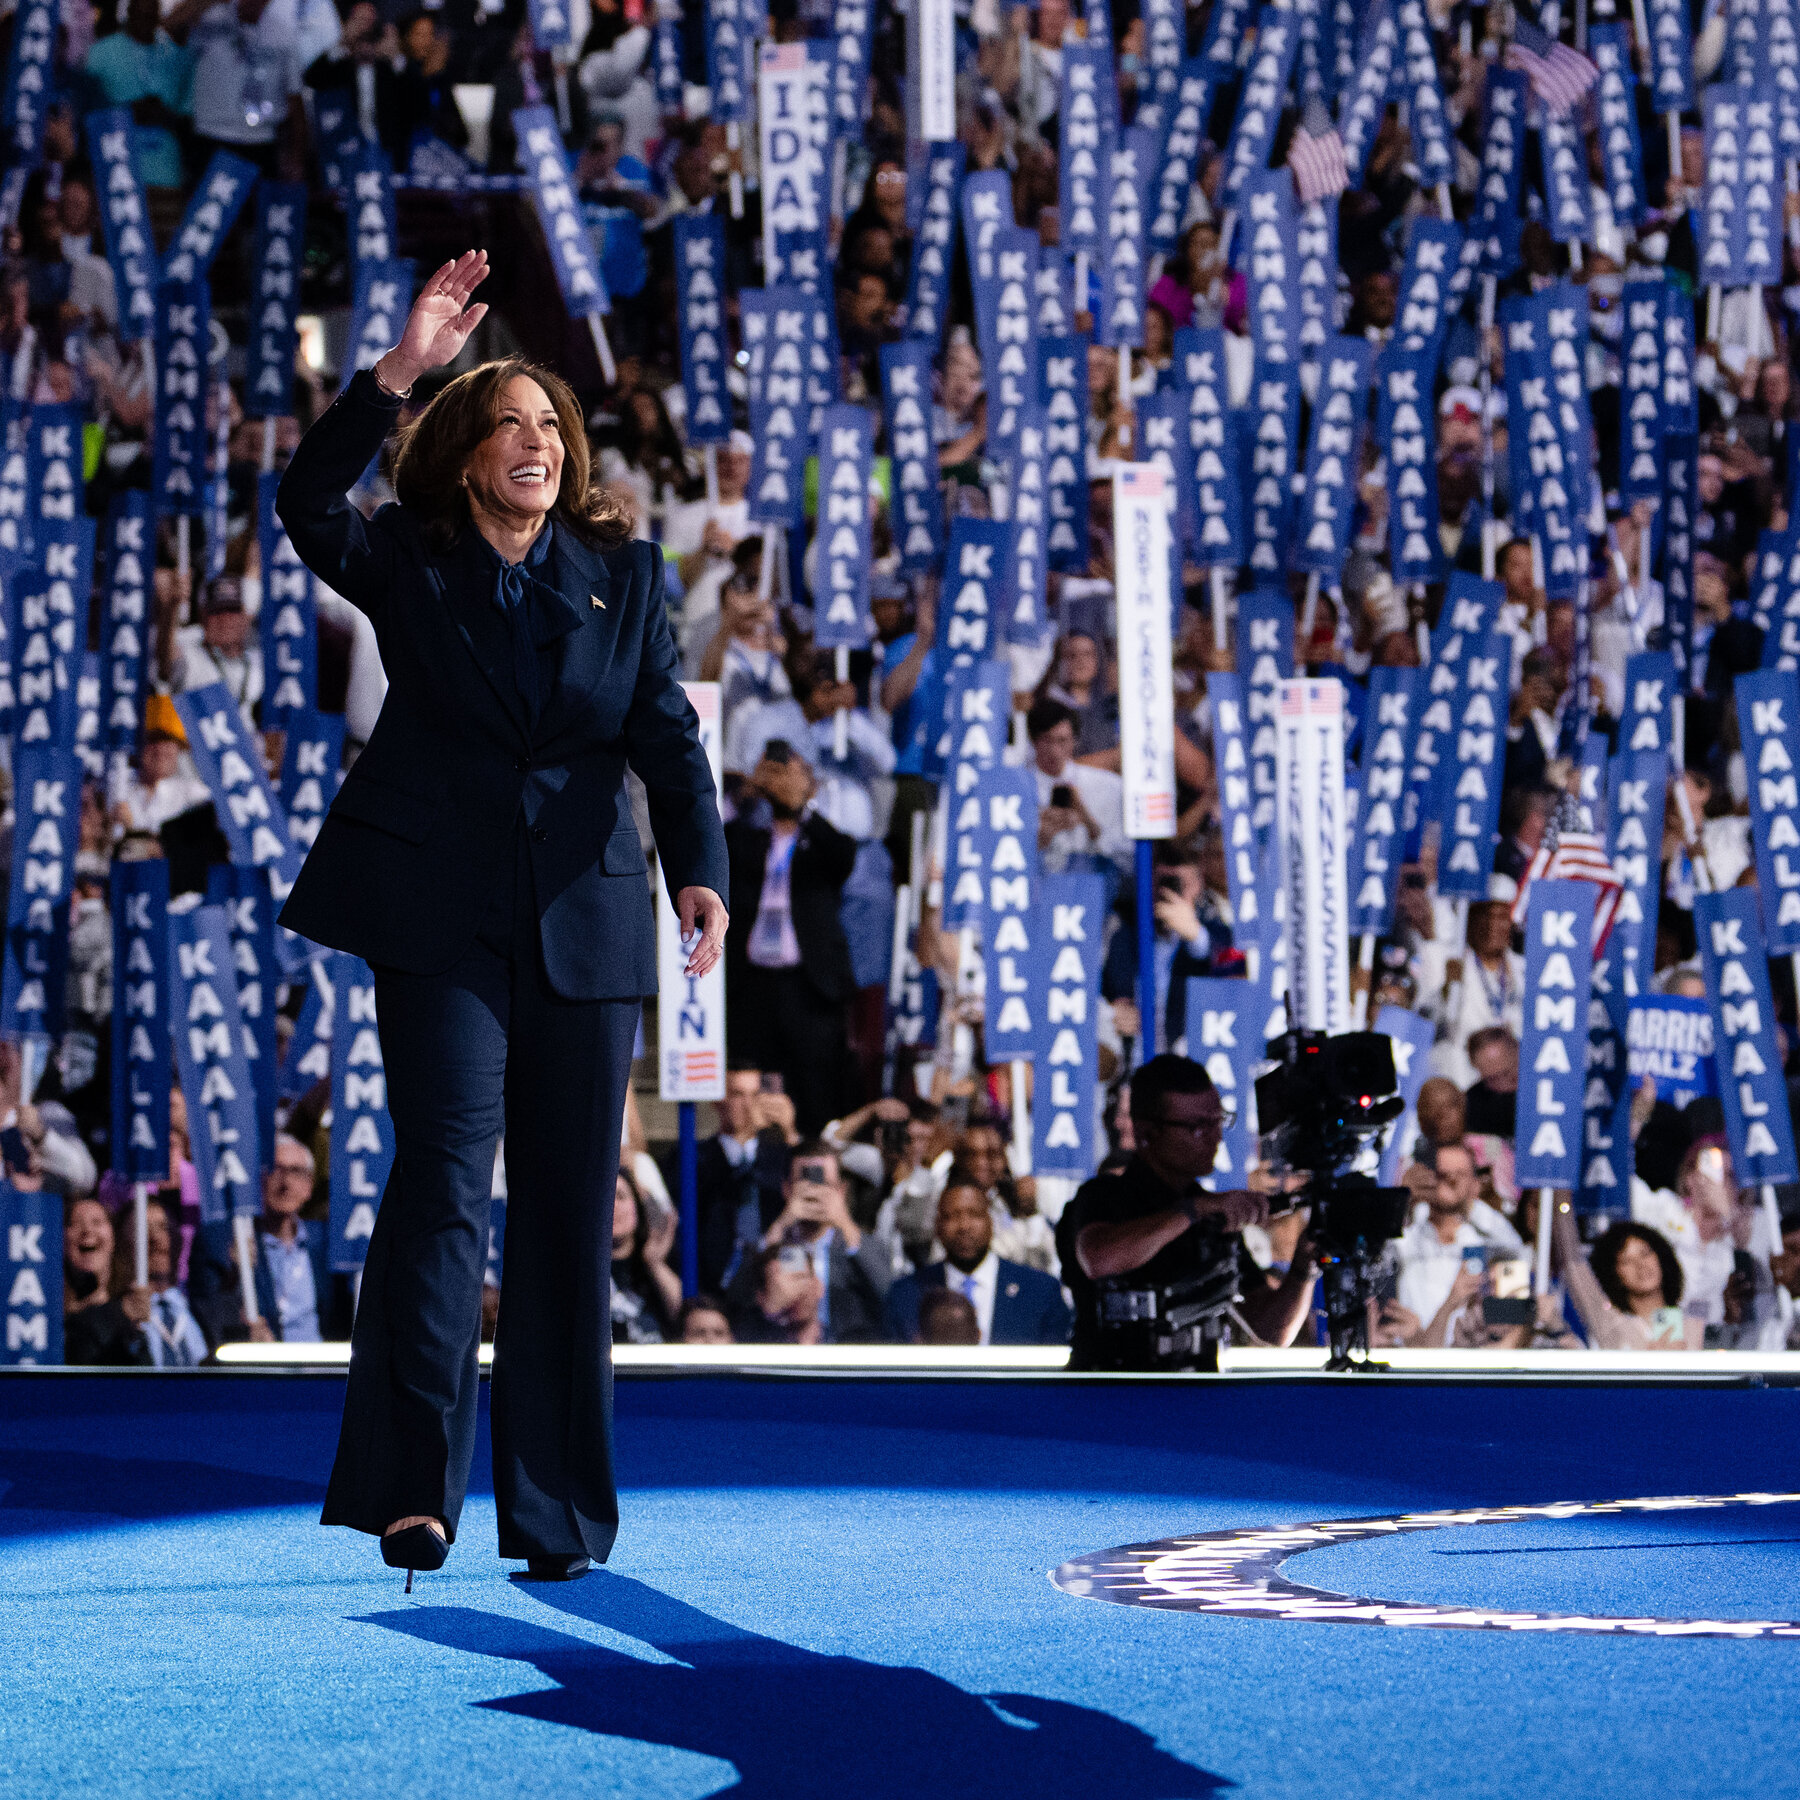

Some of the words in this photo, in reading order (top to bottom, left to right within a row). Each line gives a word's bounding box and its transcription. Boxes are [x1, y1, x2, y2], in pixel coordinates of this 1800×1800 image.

[15, 6, 50, 150] AMALA
[772, 82, 801, 210] IDA
[1067, 62, 1100, 236] KAMALA
[1151, 76, 1207, 239] KAMALA
[1402, 2, 1451, 166] KAMALA
[1601, 44, 1637, 211] KAMALA
[101, 129, 154, 316] KAMALA
[166, 171, 239, 284] KAMA
[354, 170, 390, 261] KAM
[526, 126, 599, 298] KAMALA
[912, 158, 953, 334] KAMALA
[1108, 148, 1142, 326] KAMALA
[1297, 203, 1329, 346] AMALA
[1704, 102, 1740, 268] KAMALA
[1745, 102, 1775, 266] KAMALA
[255, 203, 295, 396] KAMALA
[685, 237, 723, 425] KAMALA
[1402, 240, 1446, 351] KAM
[1663, 316, 1690, 407] KAM
[40, 425, 76, 521] KAM
[163, 303, 200, 495] KAMALA
[757, 310, 804, 502] KAMALA
[889, 365, 934, 552] KAMALA
[1047, 356, 1081, 550] KAMALA
[1186, 351, 1232, 547] KAMALA
[1252, 381, 1288, 570] KAMALA
[1305, 358, 1359, 551] KAMALA
[1388, 369, 1433, 563] KAMALA
[1520, 376, 1578, 574] KAMALA
[1628, 300, 1661, 482] KAMALA
[269, 514, 307, 710] AMALA
[826, 427, 862, 625] KAMALA
[948, 544, 992, 667] KAM
[20, 594, 52, 743] KAMA
[109, 517, 145, 732] KAMALA
[200, 709, 298, 938] KAMAL
[1355, 692, 1409, 911] KAMALA
[1447, 655, 1500, 875] KAMALA
[1751, 699, 1800, 926] KAMALA
[15, 780, 67, 1014] KAMALA
[989, 794, 1033, 1033] KAMALA
[126, 893, 156, 1150] KAMALA
[178, 939, 250, 1190] KAMALA
[1045, 904, 1087, 1149] KAMALA
[1529, 909, 1578, 1158] KAMALA
[1626, 1008, 1715, 1056] ARRIS
[1710, 917, 1778, 1158] KAMALA
[6, 1223, 49, 1365] KAM
